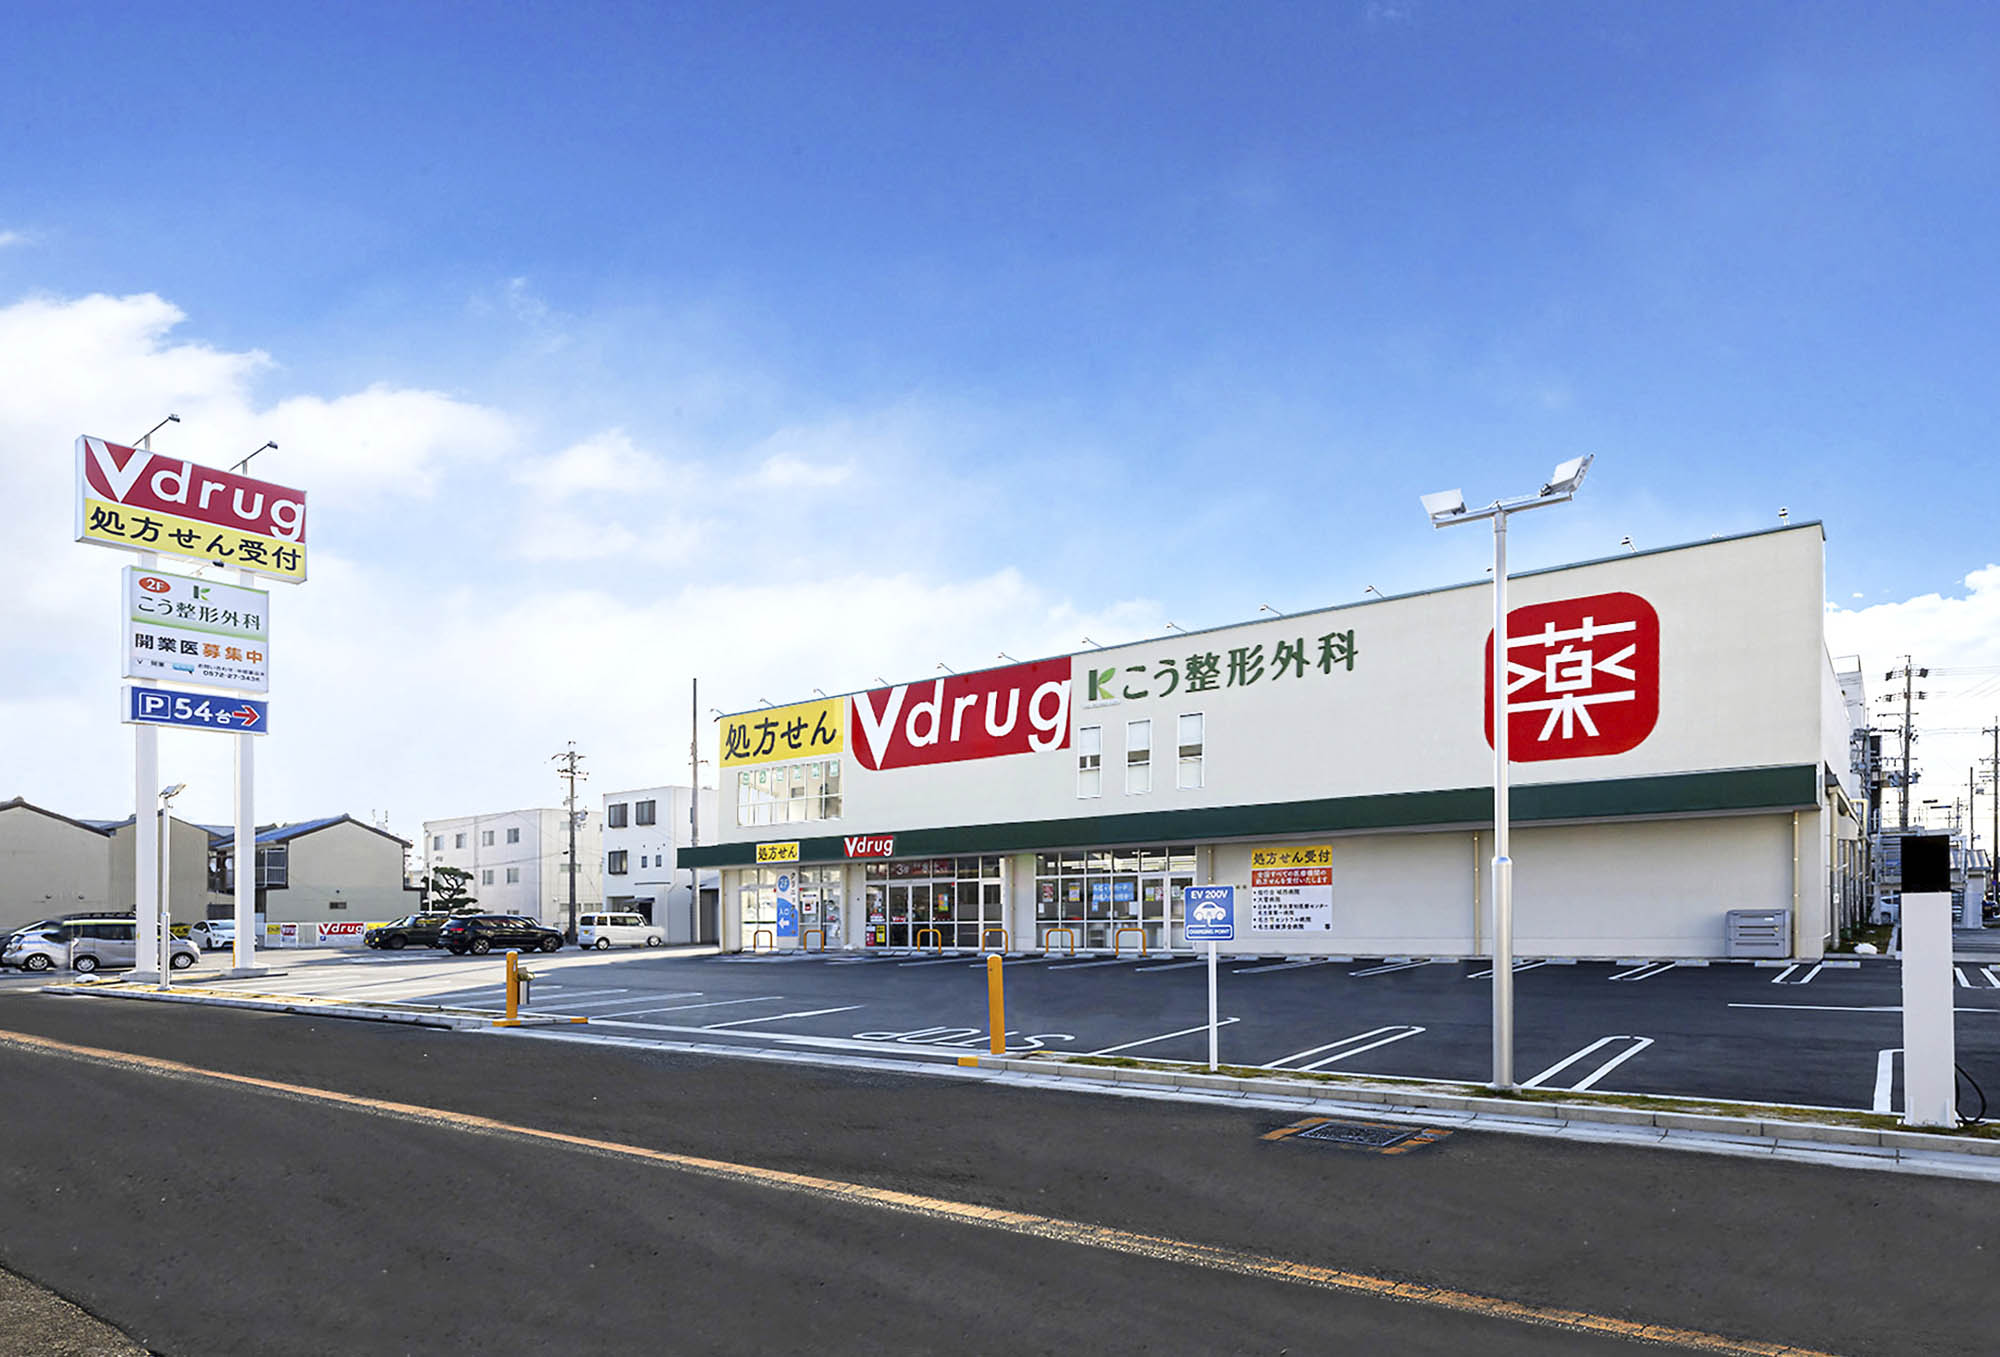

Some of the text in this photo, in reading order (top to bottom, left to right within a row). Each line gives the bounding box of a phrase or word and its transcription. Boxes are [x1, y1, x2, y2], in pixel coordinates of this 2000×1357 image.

[89, 506, 302, 572] 処方せん受付
[147, 579, 166, 591] 2F
[138, 596, 261, 630] こう整形外科
[135, 633, 263, 664] 開業医募集中
[1123, 630, 1358, 699] こう整形外科
[1506, 616, 1637, 741] 薬
[145, 696, 233, 724] P 54台
[724, 710, 837, 761] 処方せん
[757, 846, 798, 861] 処方せん
[1254, 849, 1330, 865] 処方せん受付
[1191, 890, 1228, 899] EV 200V
